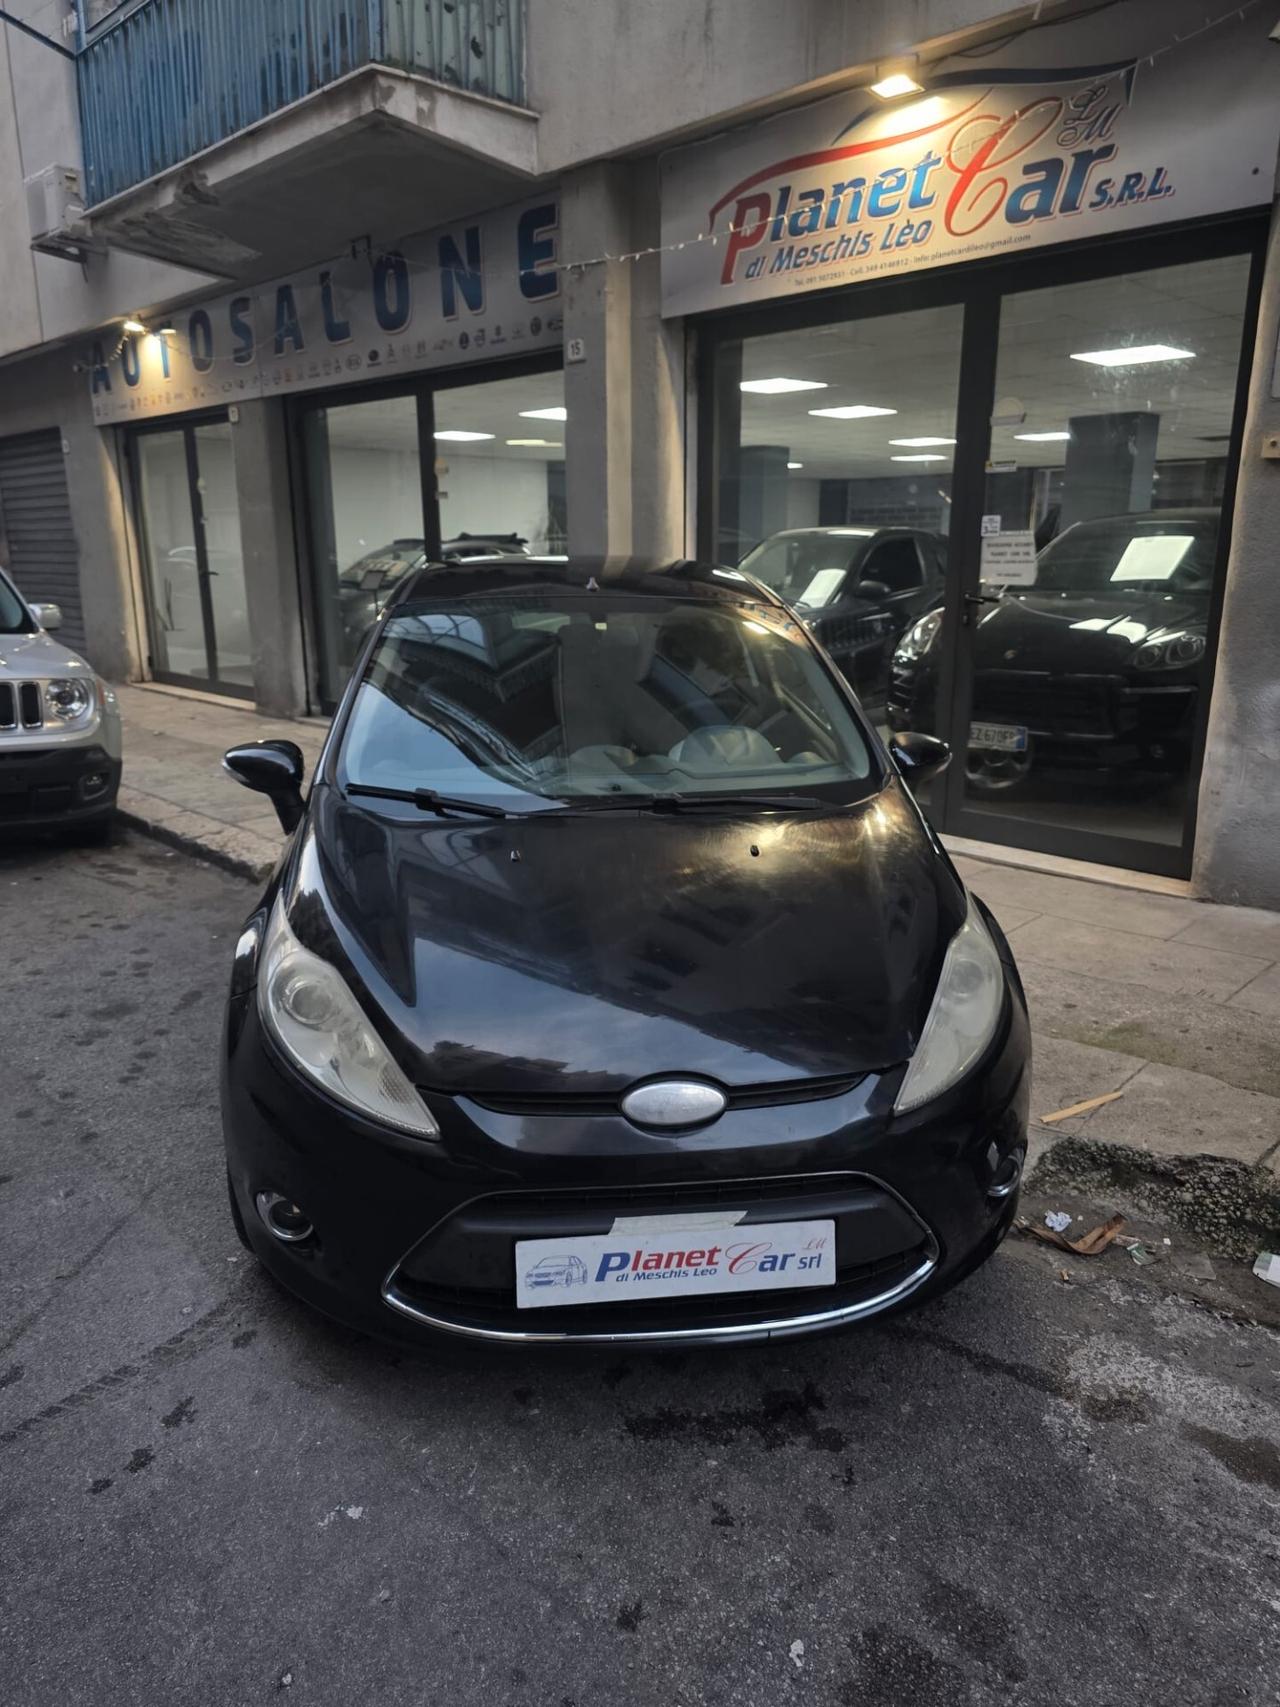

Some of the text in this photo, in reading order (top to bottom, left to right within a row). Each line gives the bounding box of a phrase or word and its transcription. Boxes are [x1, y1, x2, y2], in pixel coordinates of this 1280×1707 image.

[721, 96, 1172, 285] Planet Car S.R.L.
[745, 257, 766, 279] di
[769, 231, 874, 274] Meschis
[92, 203, 559, 395] AUTOSALONE
[595, 1242, 822, 1282] Planet Car srl
[616, 1267, 717, 1282] di Meschis Leo
